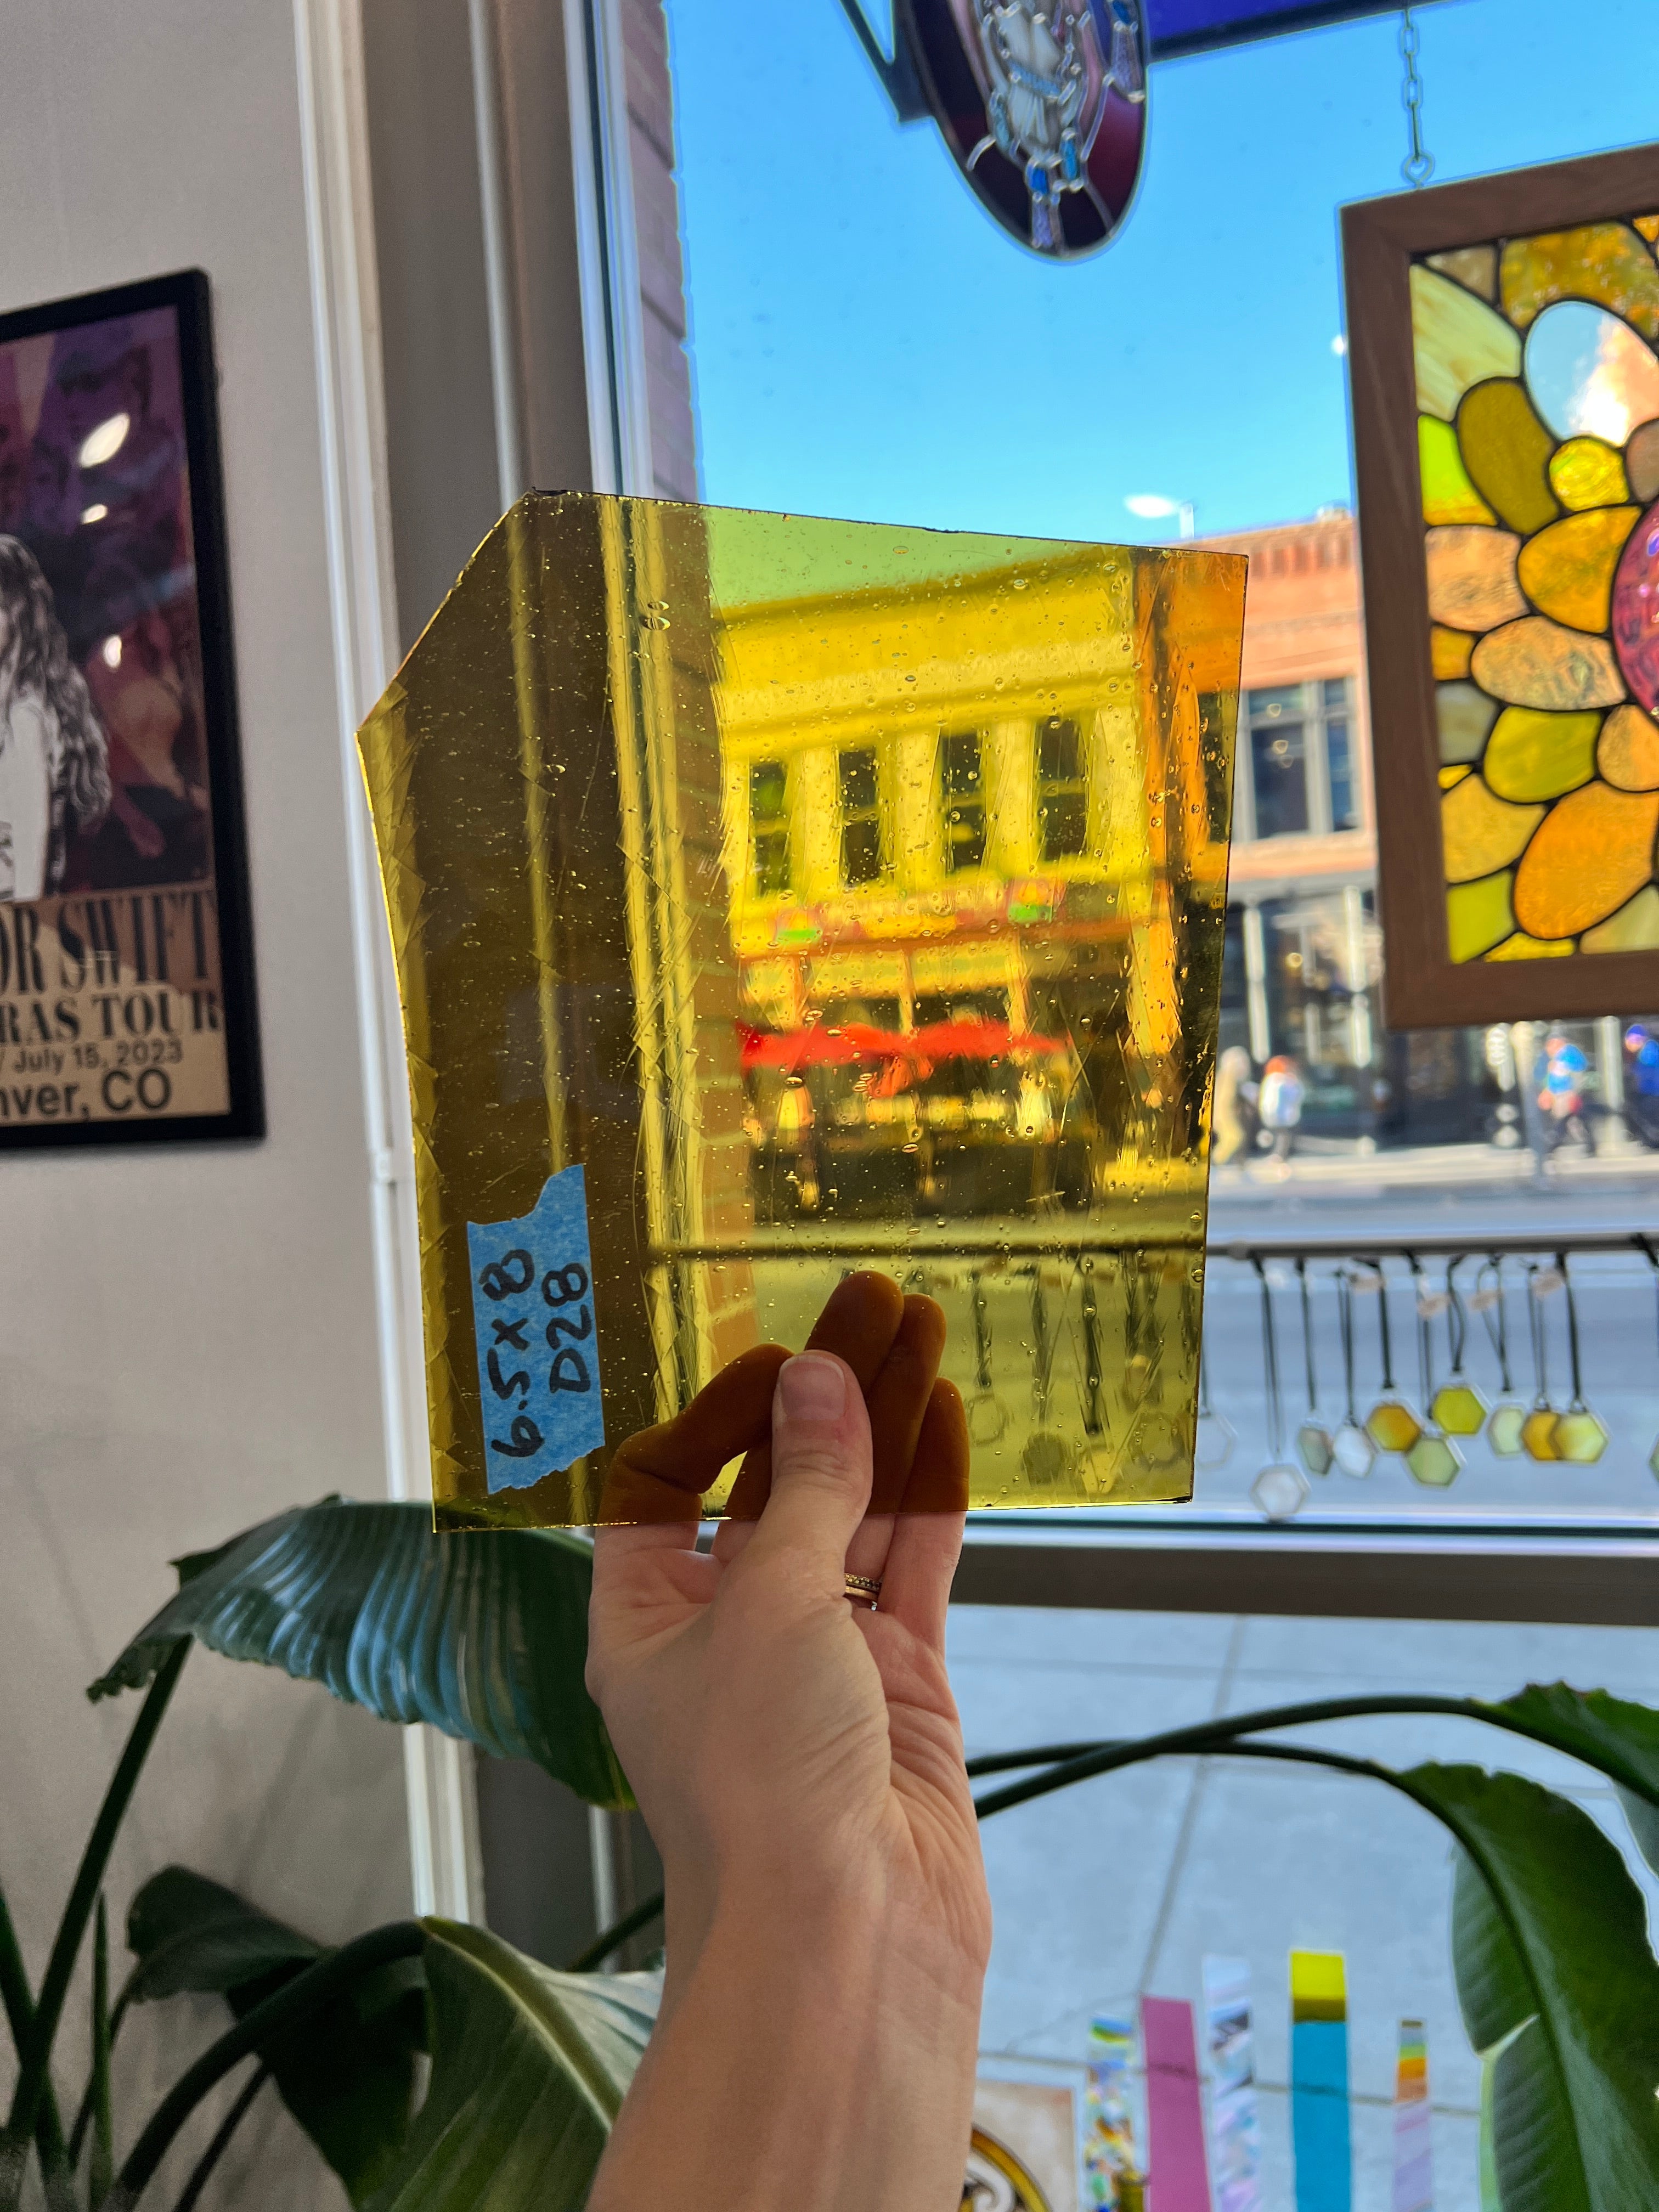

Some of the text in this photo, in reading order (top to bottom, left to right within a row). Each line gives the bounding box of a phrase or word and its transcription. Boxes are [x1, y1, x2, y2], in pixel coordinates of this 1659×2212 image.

[57, 890, 215, 992] SWIFT
[91, 990, 221, 1039] TOUR
[14, 1047, 64, 1075] July
[116, 1037, 184, 1066] 2023
[101, 1067, 173, 1112] CO
[541, 1262, 592, 1394] D28
